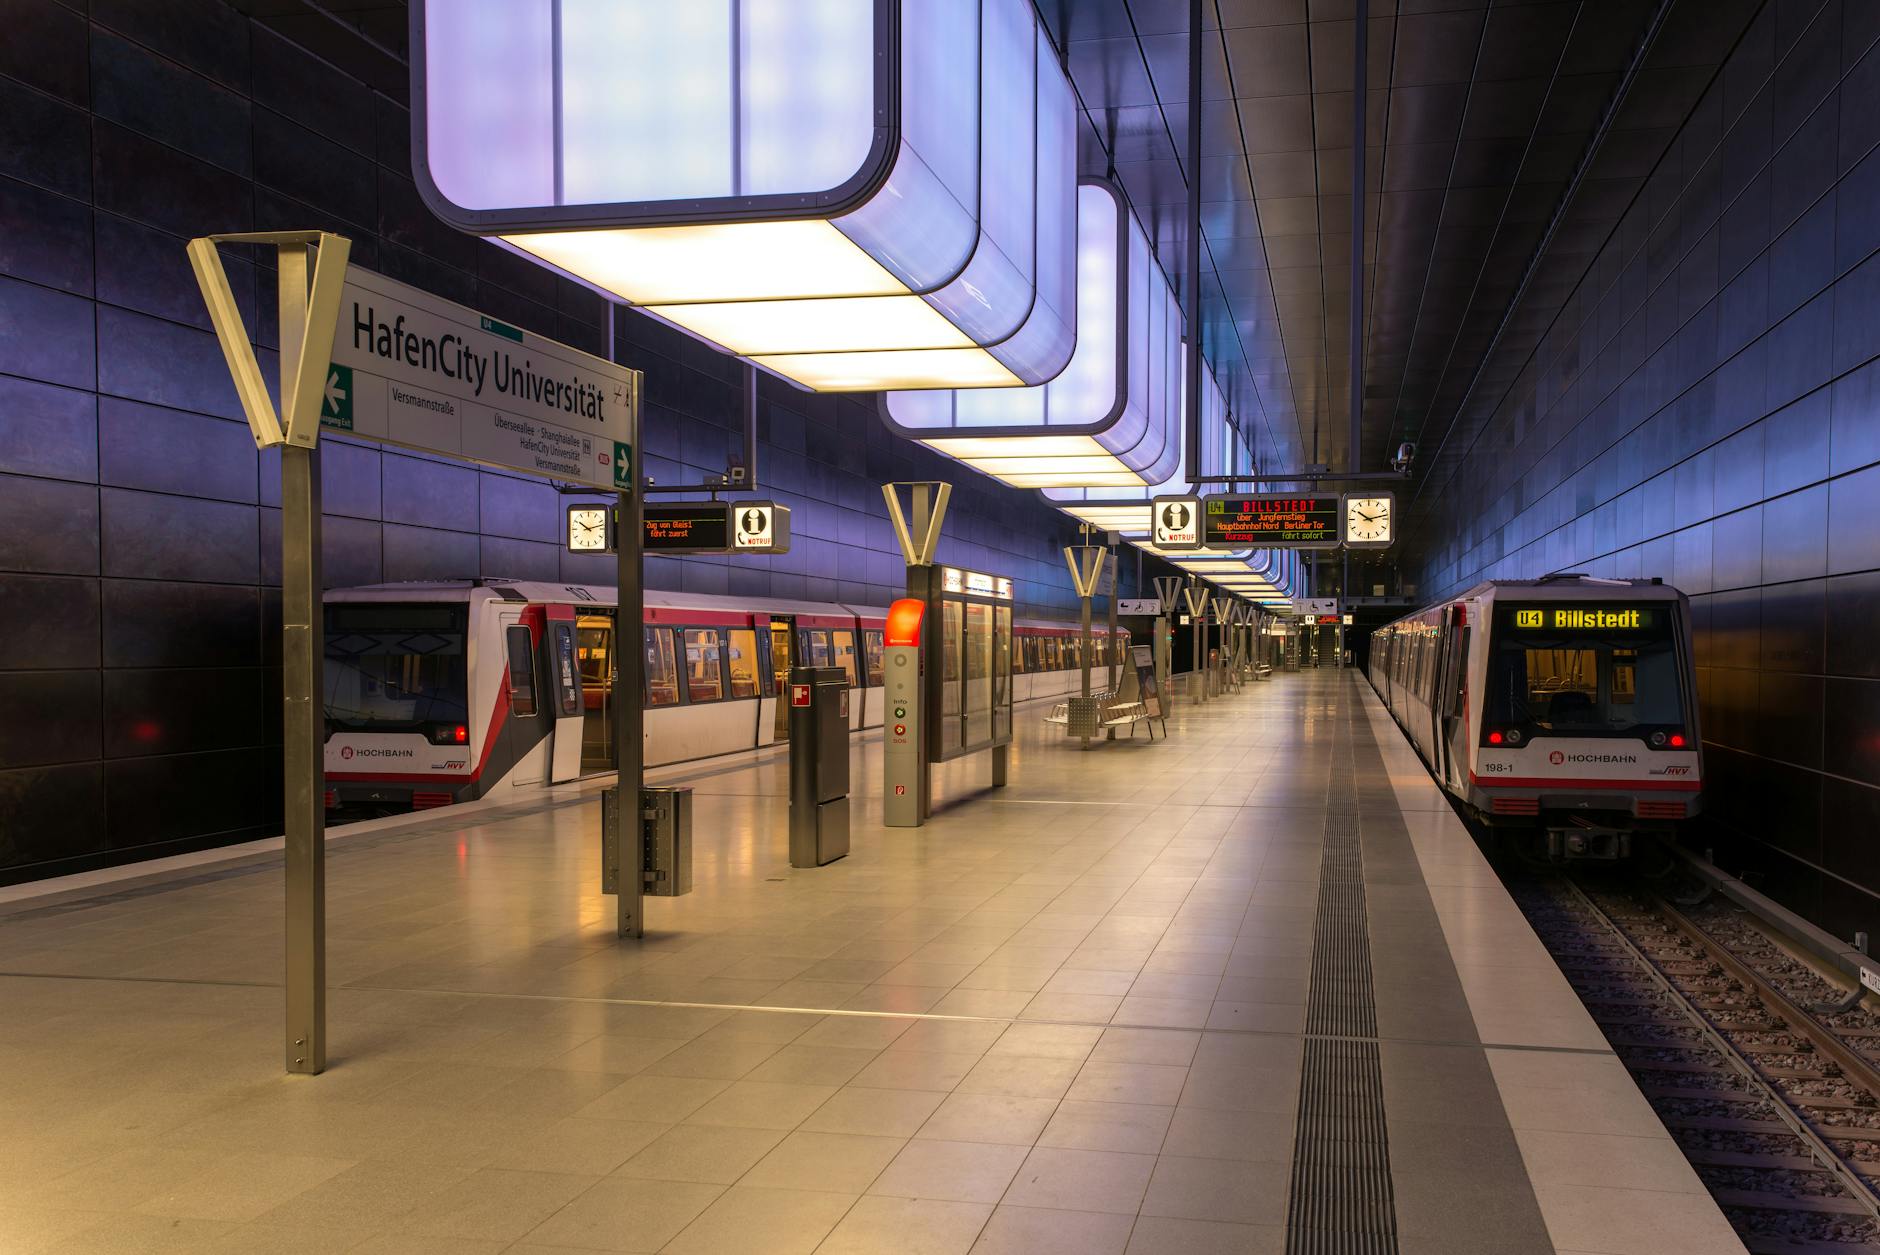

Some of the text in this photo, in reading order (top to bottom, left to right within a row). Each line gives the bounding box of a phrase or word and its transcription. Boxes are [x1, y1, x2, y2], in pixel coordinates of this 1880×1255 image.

[483, 319, 492, 330] U4
[354, 302, 604, 422] HafenCity Universität
[392, 387, 454, 416] Versmannstraße
[494, 412, 580, 448] Überseeallee Shanghaiallee
[520, 438, 580, 461] HafenCity Universität
[535, 456, 581, 476] Versmannstraße
[1243, 500, 1316, 513] BILLSTEDT
[1237, 513, 1306, 522] über Jungfernstieg
[647, 521, 657, 530] Zug
[1217, 520, 1325, 531] Hauptbahnhof Nord Berliner Tor
[1225, 532, 1253, 541] Kurzzug
[1301, 532, 1324, 540] sofort
[1520, 610, 1640, 628] U4 Billstedt
[356, 749, 413, 757] HOCHBAHN
[1568, 754, 1637, 764] HOCHBAHN
[1485, 763, 1513, 773] 198-1
[1667, 767, 1689, 776] HVV
